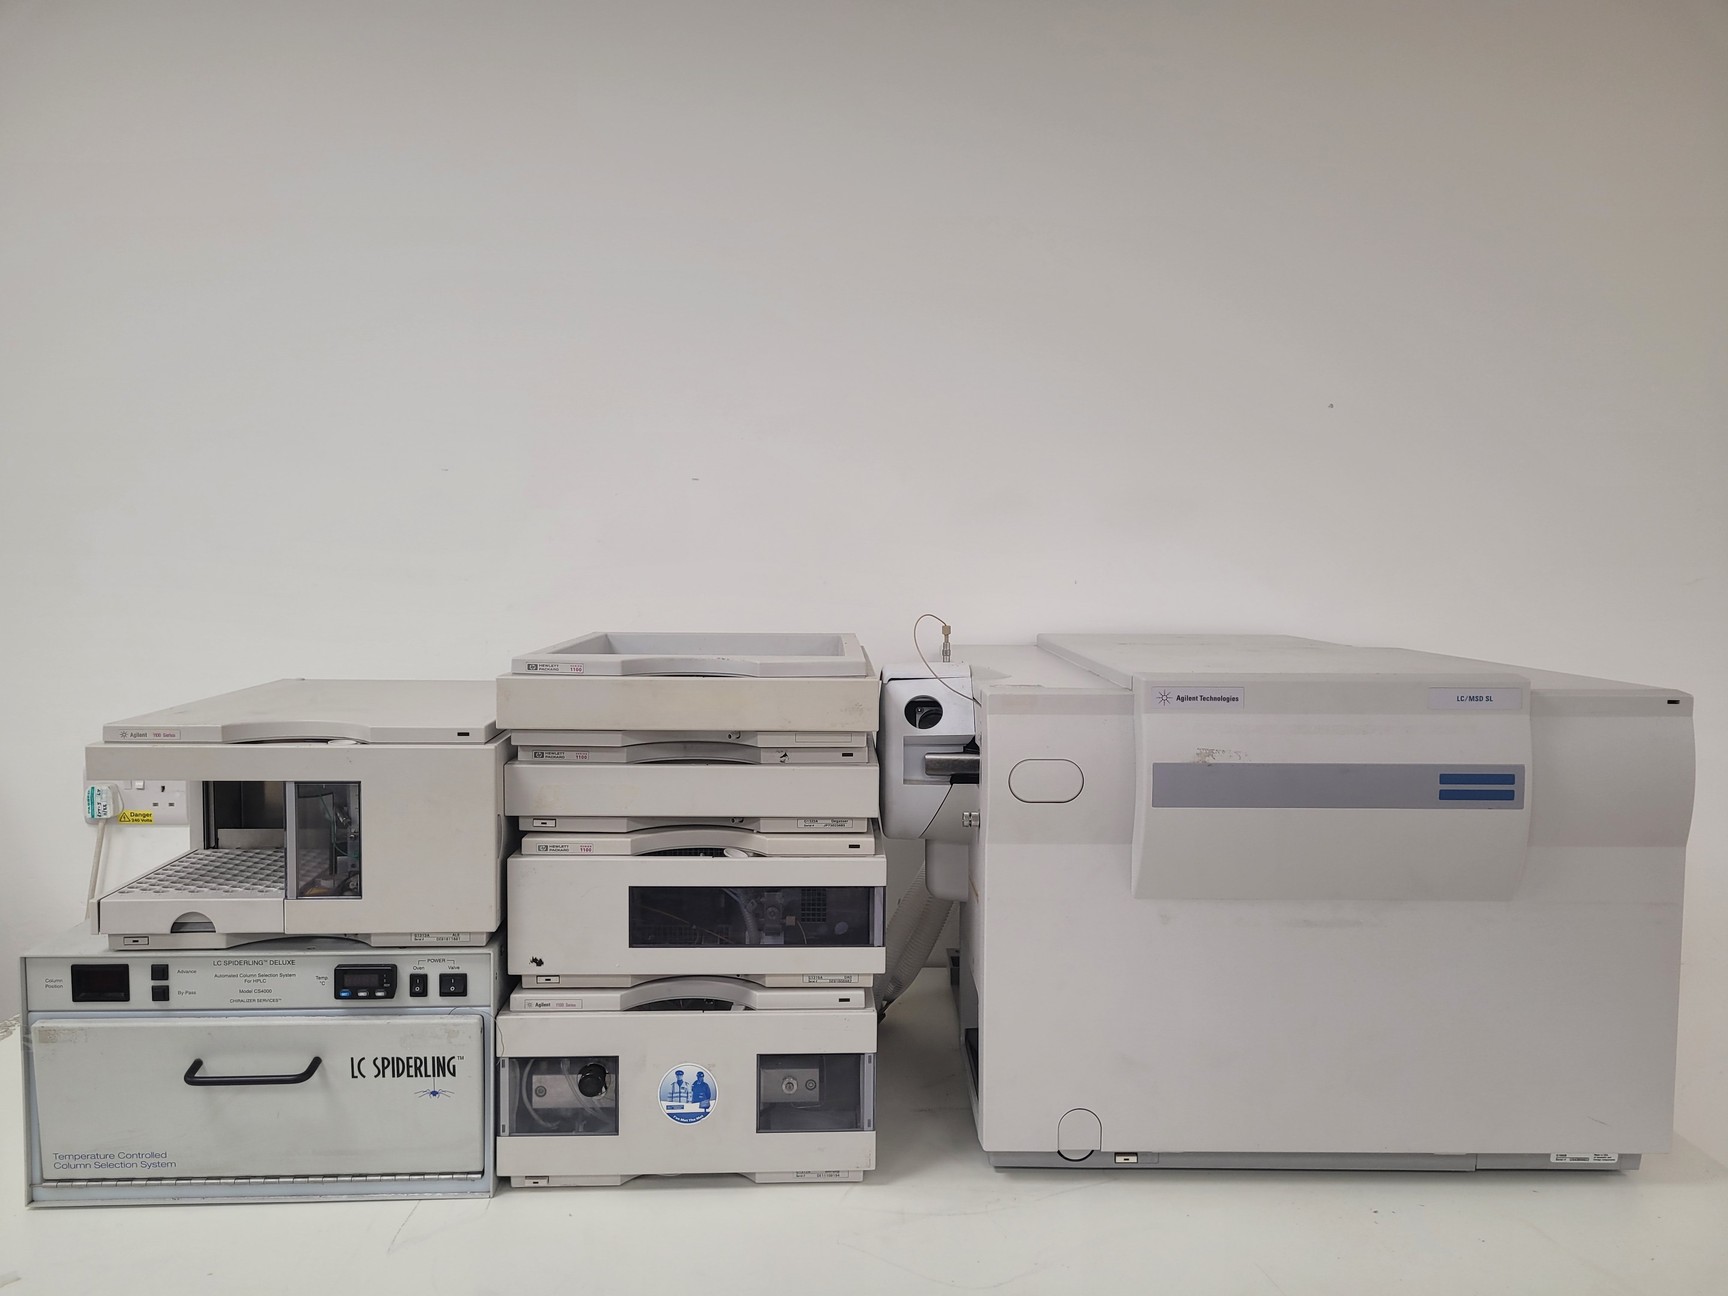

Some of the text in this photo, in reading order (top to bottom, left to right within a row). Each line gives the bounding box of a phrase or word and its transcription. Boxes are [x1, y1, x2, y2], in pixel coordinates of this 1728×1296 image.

[1176, 694, 1239, 703] Agilent Technologies
[130, 811, 153, 819] Danger
[350, 1056, 366, 1079] LC
[52, 1151, 168, 1161] Temperature Controlled
[53, 1160, 177, 1170] Column Selection System
